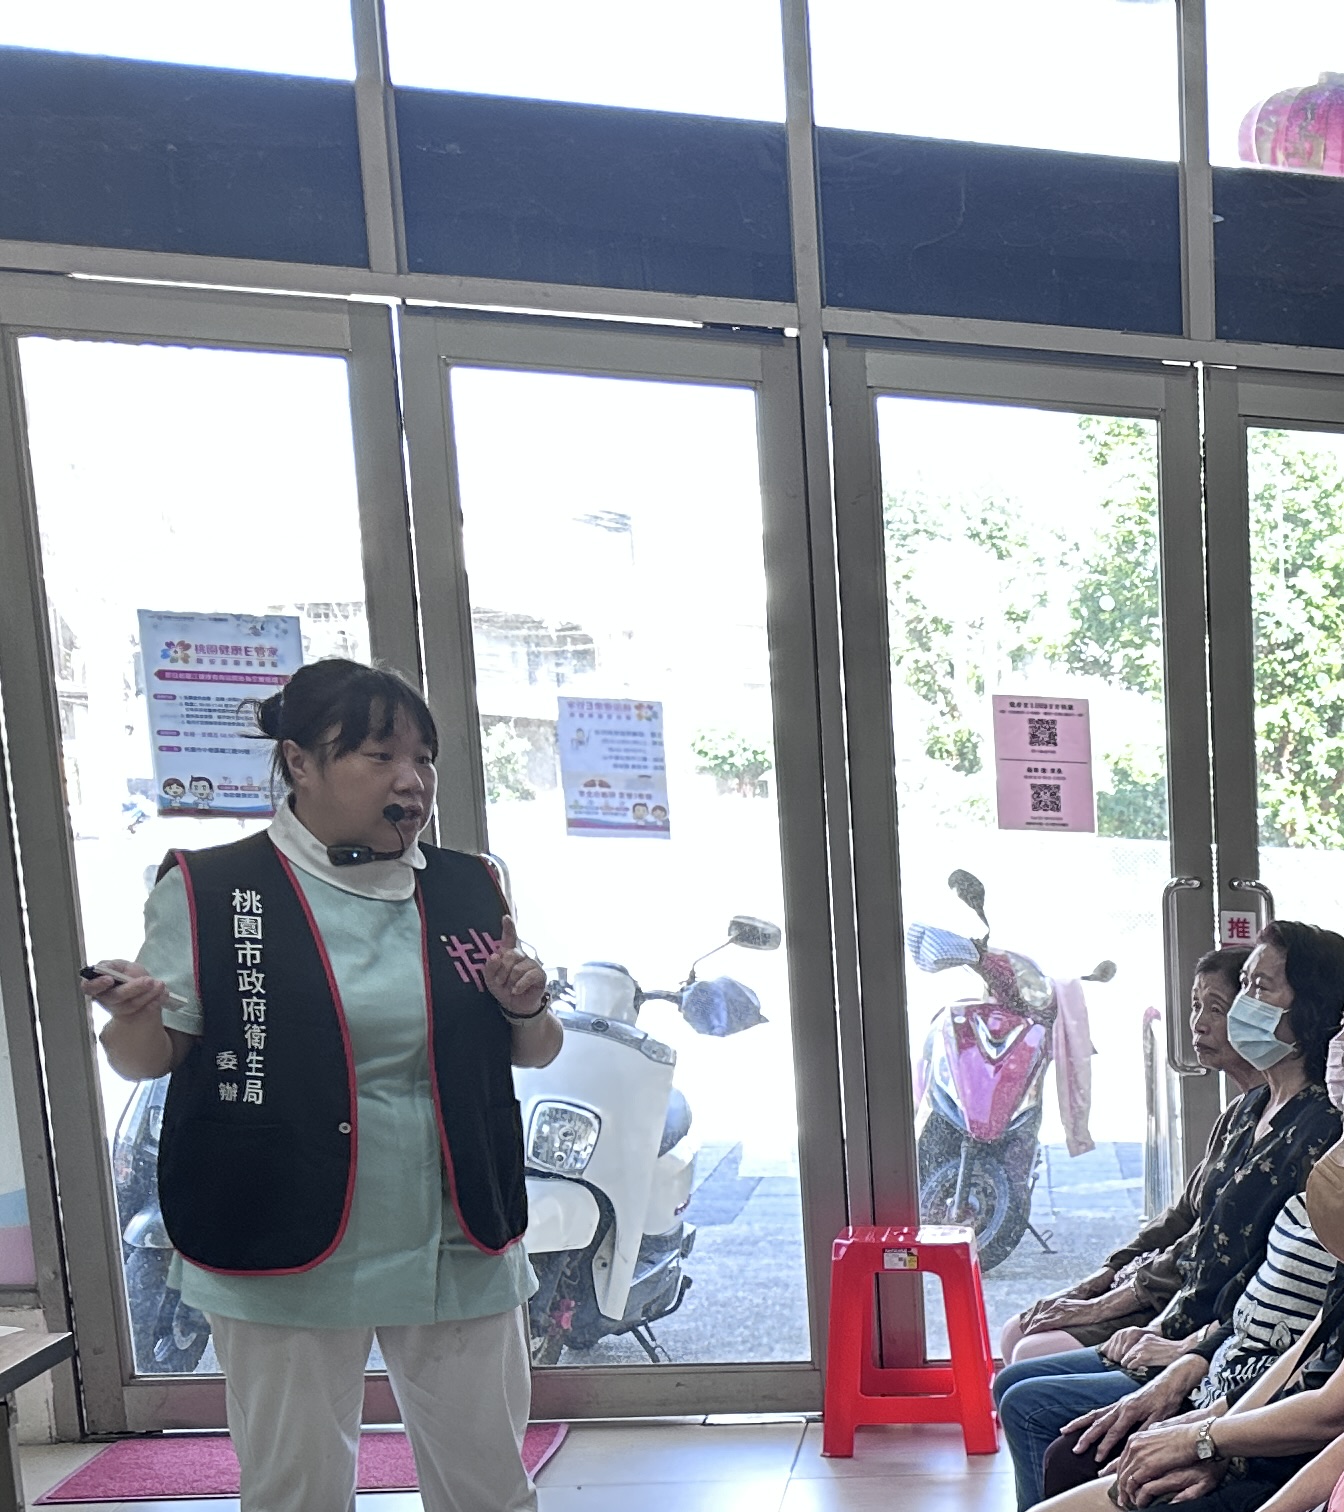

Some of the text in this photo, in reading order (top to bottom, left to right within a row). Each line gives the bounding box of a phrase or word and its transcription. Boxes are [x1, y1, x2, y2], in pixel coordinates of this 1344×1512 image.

[1228, 917, 1251, 939] 推
[231, 888, 267, 1105] 桃園市政府衛生局
[215, 1050, 238, 1102] 委辦
